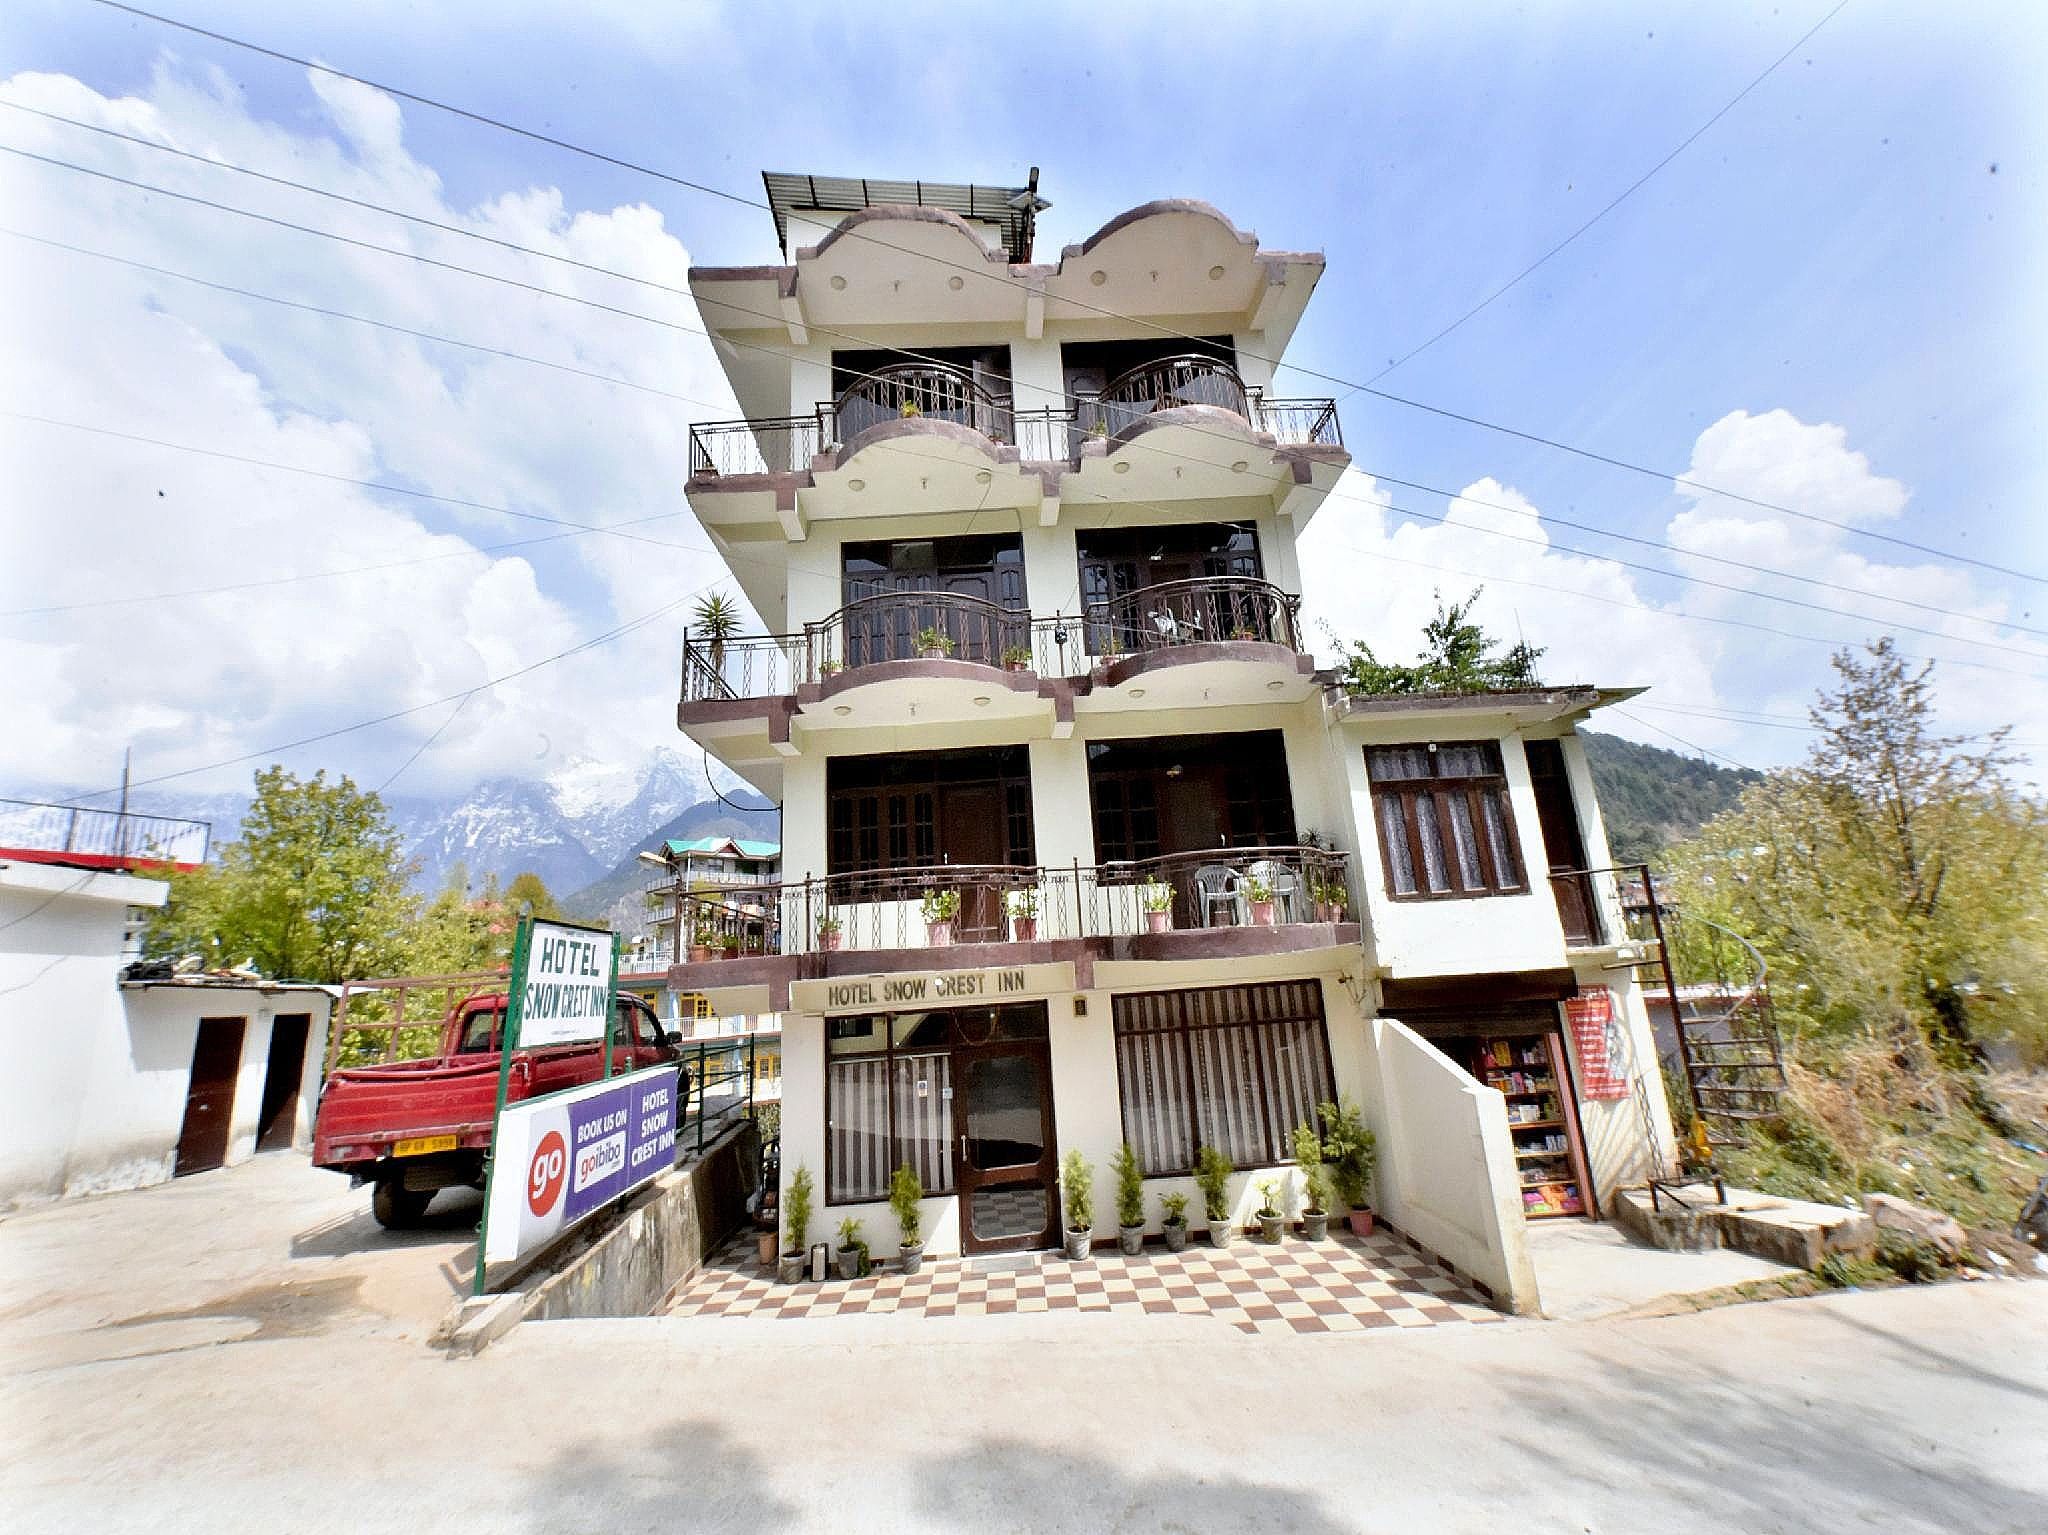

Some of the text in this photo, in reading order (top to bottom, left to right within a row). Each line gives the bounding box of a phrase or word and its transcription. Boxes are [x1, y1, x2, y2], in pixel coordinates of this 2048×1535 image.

[540, 937, 600, 977] HOTEL
[525, 982, 608, 1020] SNOW CREST INN
[828, 970, 1025, 1007] HOTEL SNOW CREST INN
[642, 1088, 669, 1113] HOTEL
[577, 1109, 627, 1143] BOOK US ON
[641, 1109, 669, 1138] SNOW
[581, 1141, 621, 1184] goibibo
[631, 1128, 675, 1168] CREST INN
[532, 1148, 563, 1200] go
